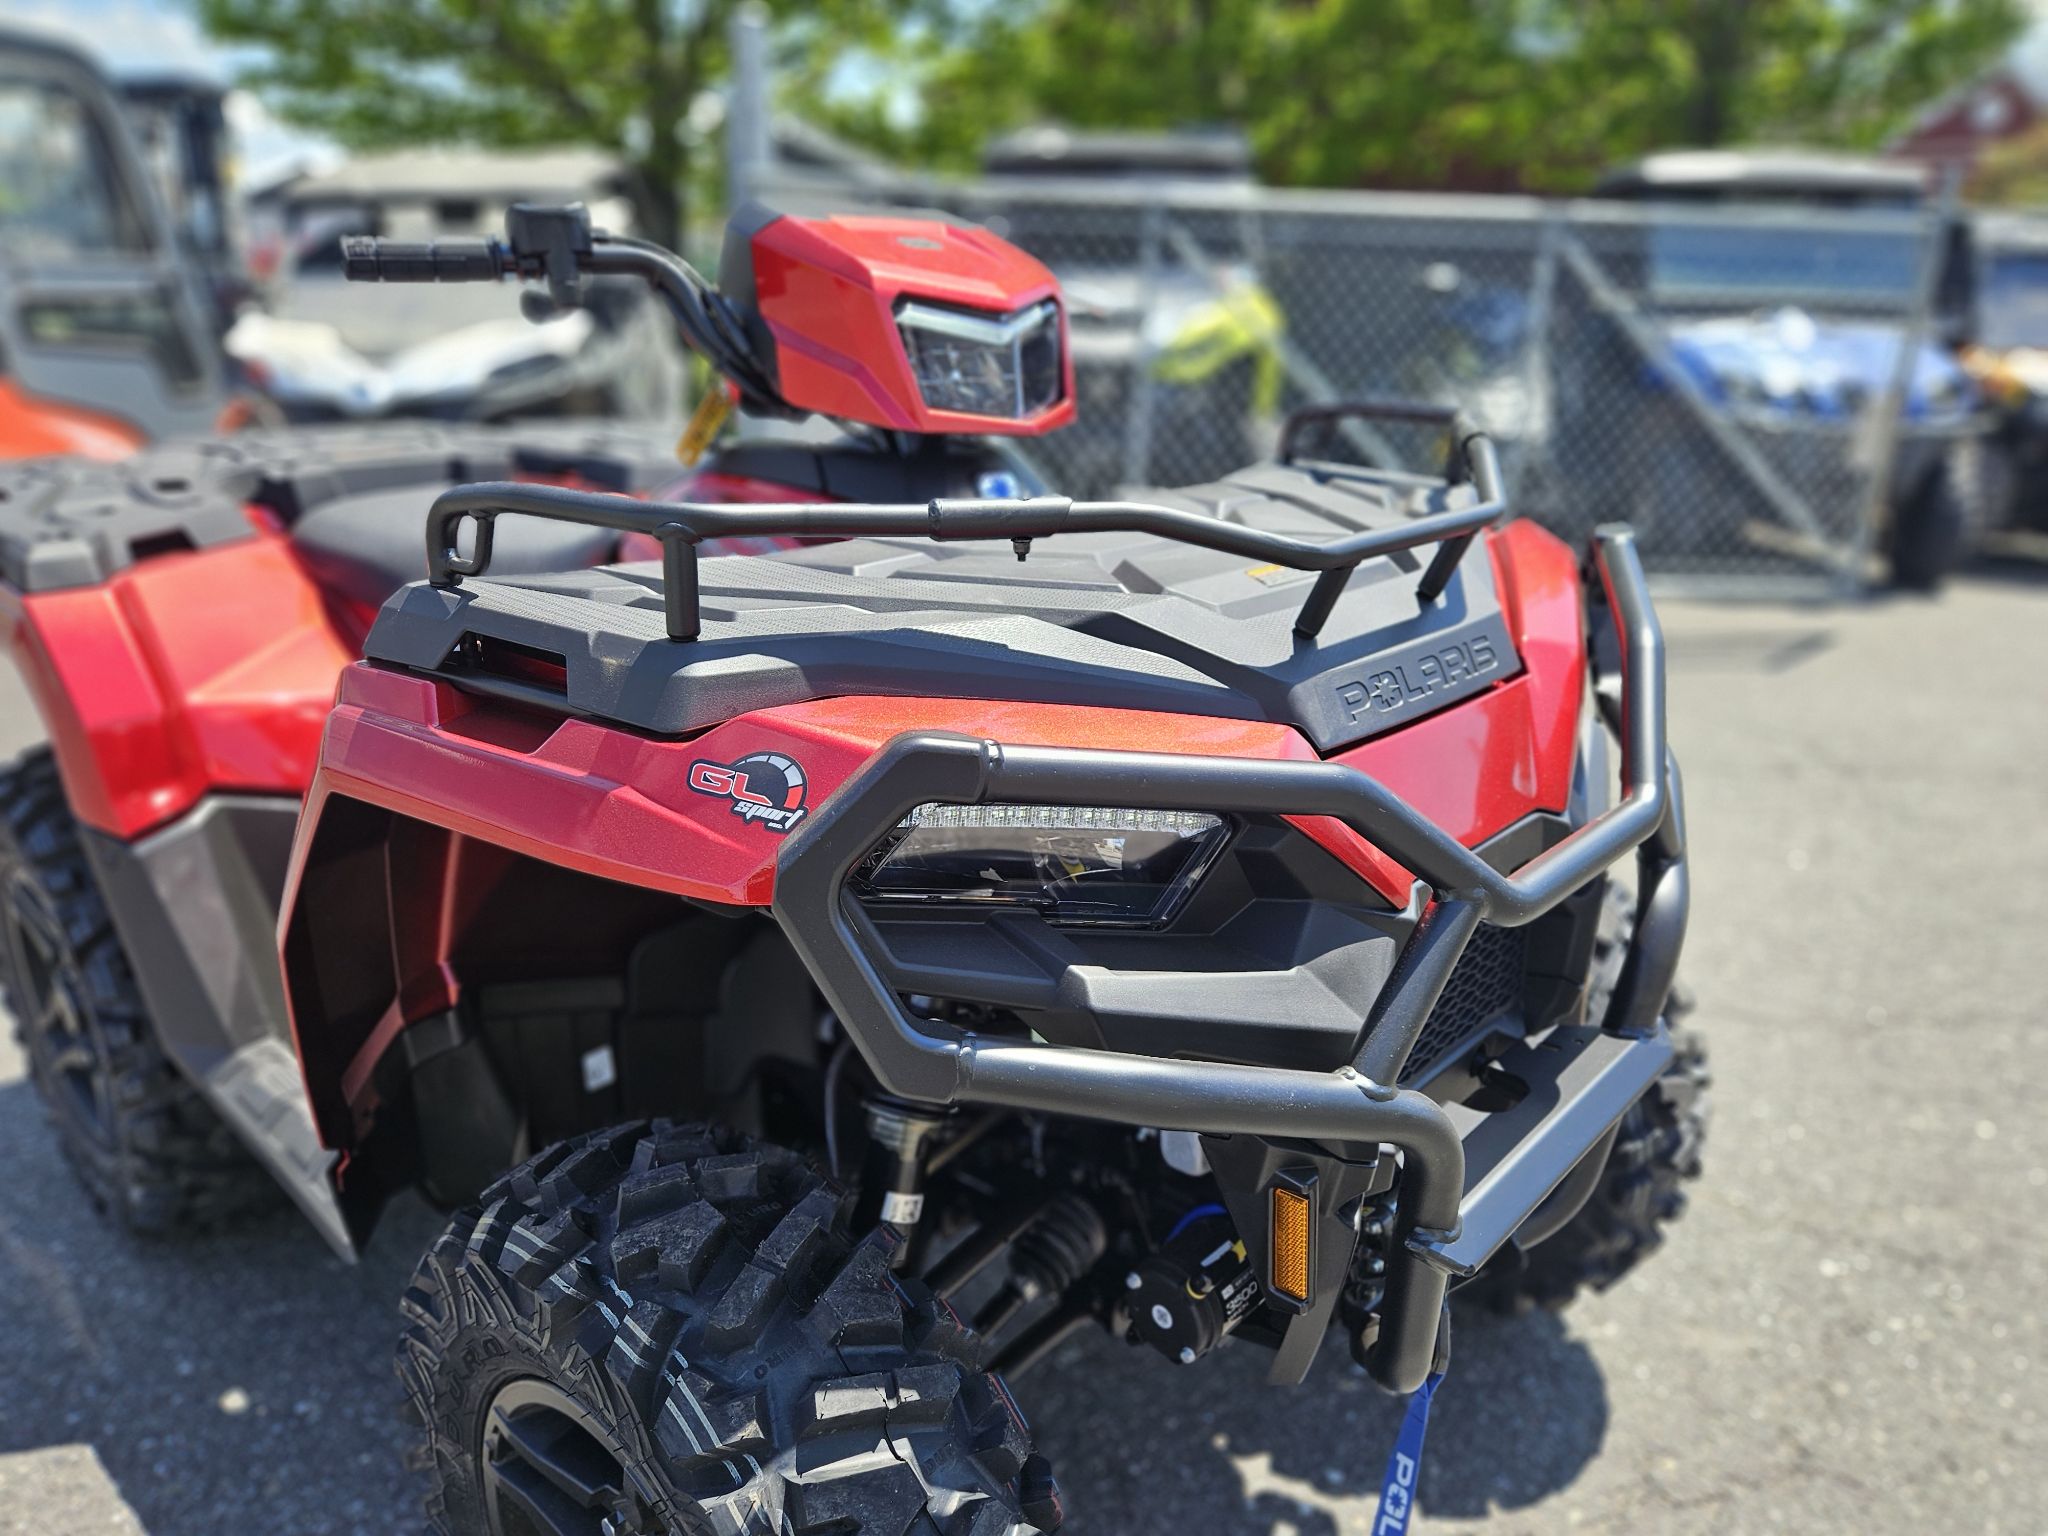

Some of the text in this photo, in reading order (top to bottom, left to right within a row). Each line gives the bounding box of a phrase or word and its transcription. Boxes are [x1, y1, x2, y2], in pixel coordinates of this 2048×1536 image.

[1334, 634, 1499, 727] POLARIS
[689, 762, 773, 807] GL
[733, 800, 805, 830] sport
